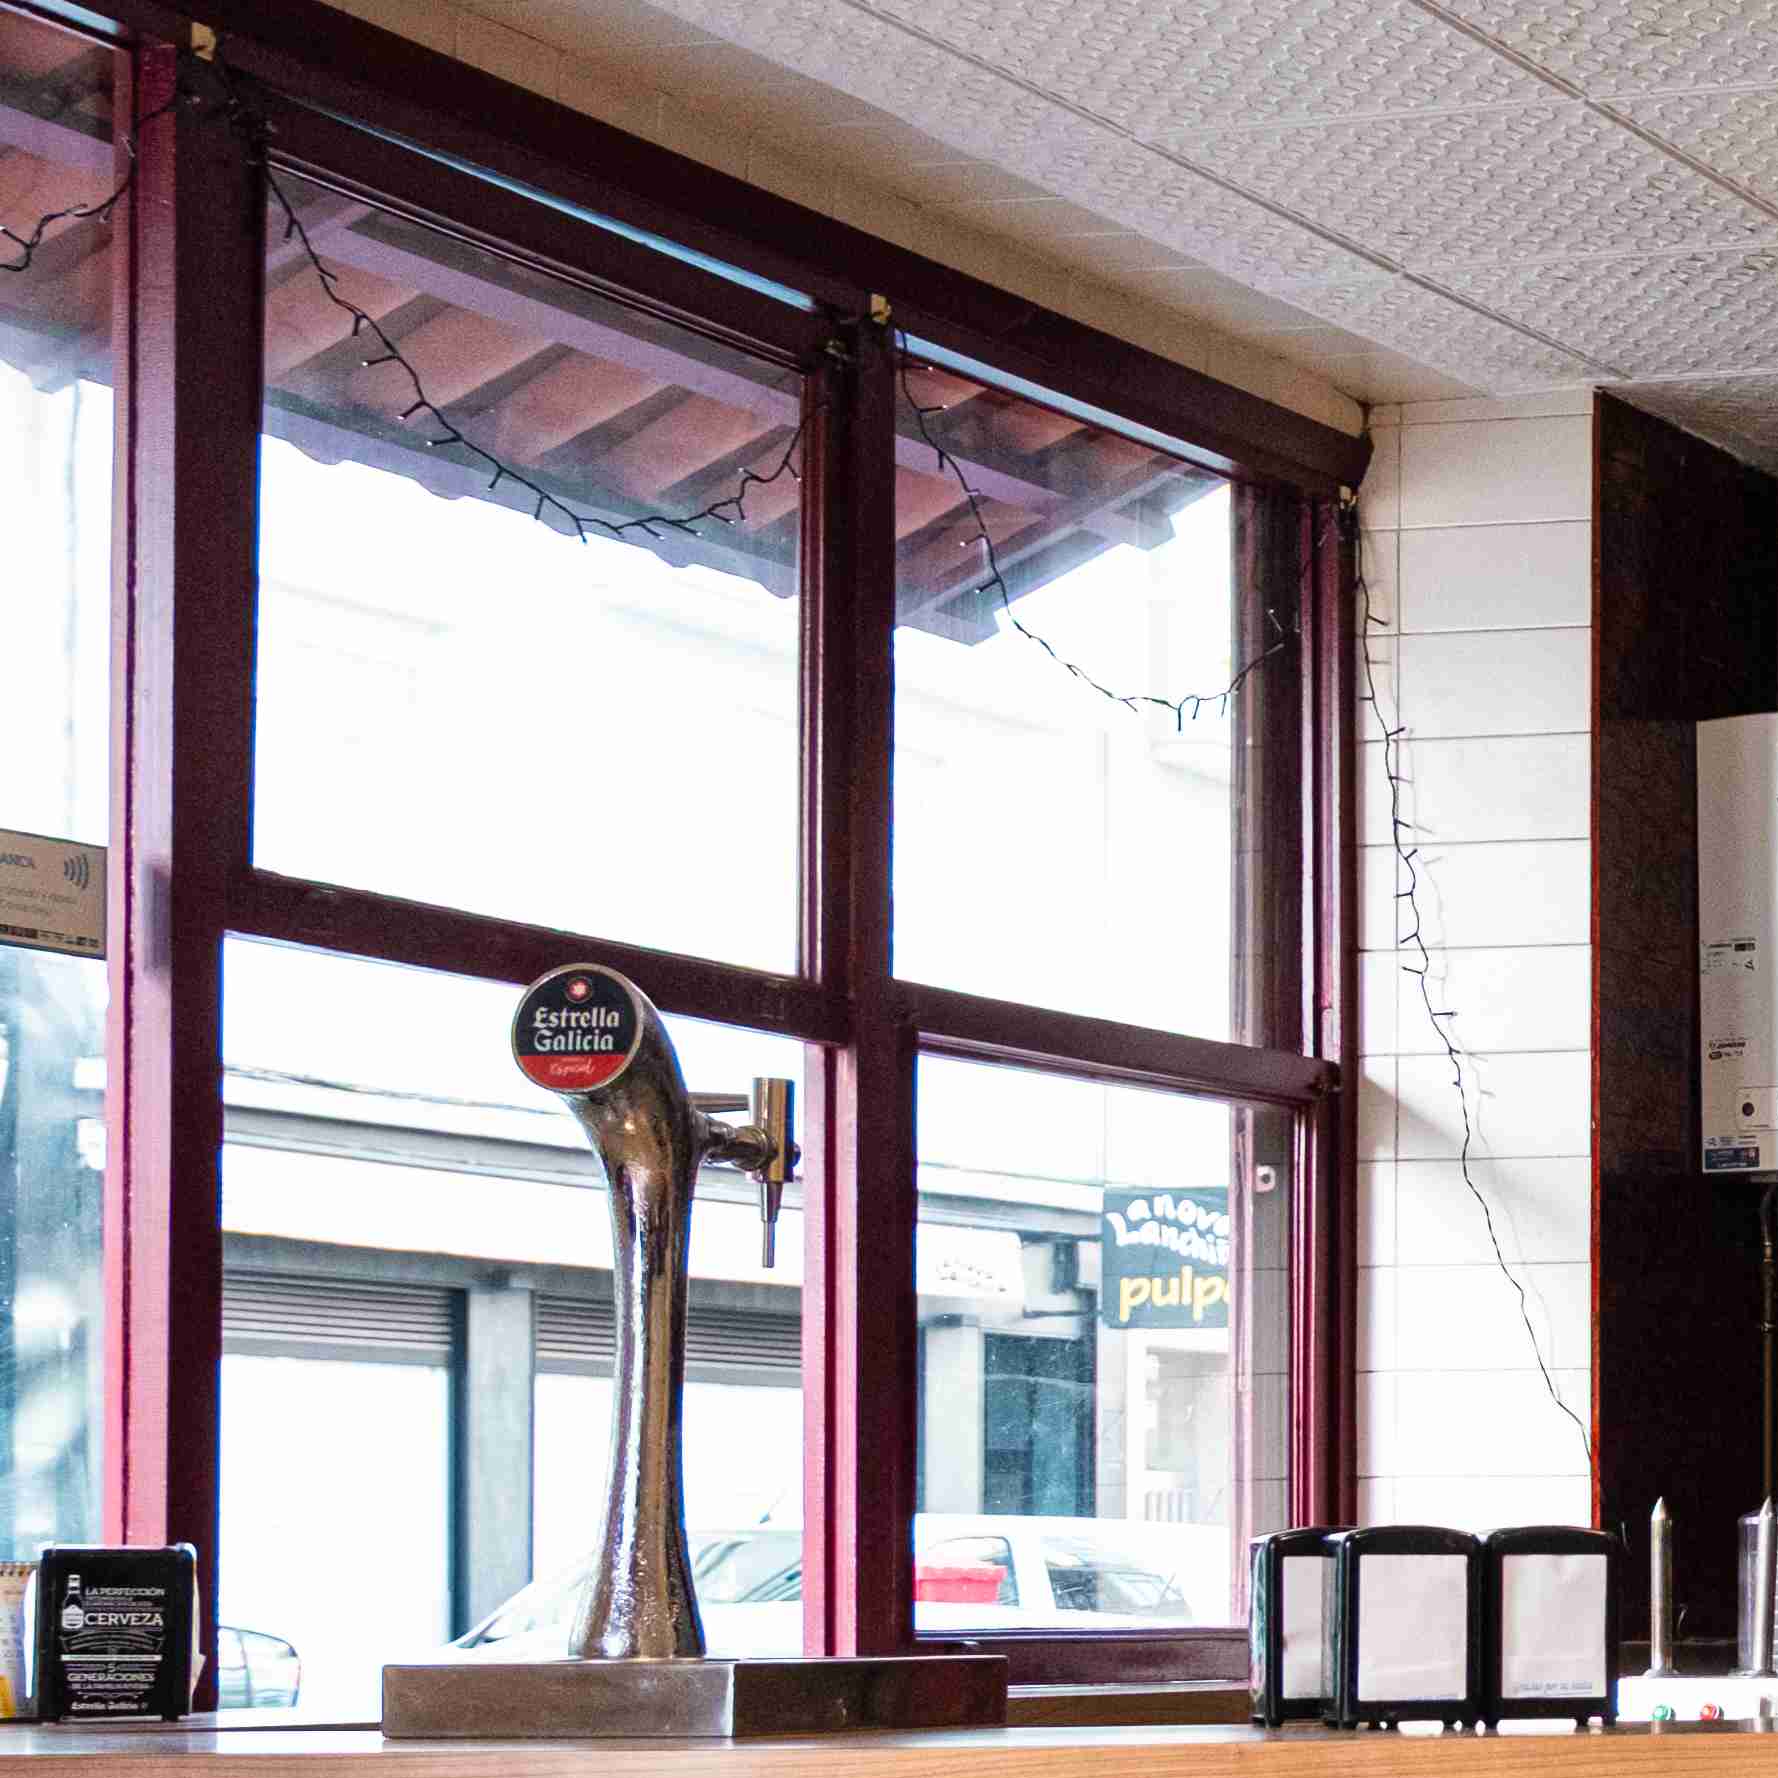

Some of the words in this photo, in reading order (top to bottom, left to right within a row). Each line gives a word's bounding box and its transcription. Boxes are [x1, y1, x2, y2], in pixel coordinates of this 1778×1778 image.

[533, 1006, 620, 1028] Estrella
[534, 1029, 614, 1052] Galicia
[1119, 1265, 1231, 1323] pulp
[84, 1612, 164, 1626] CERVEZA
